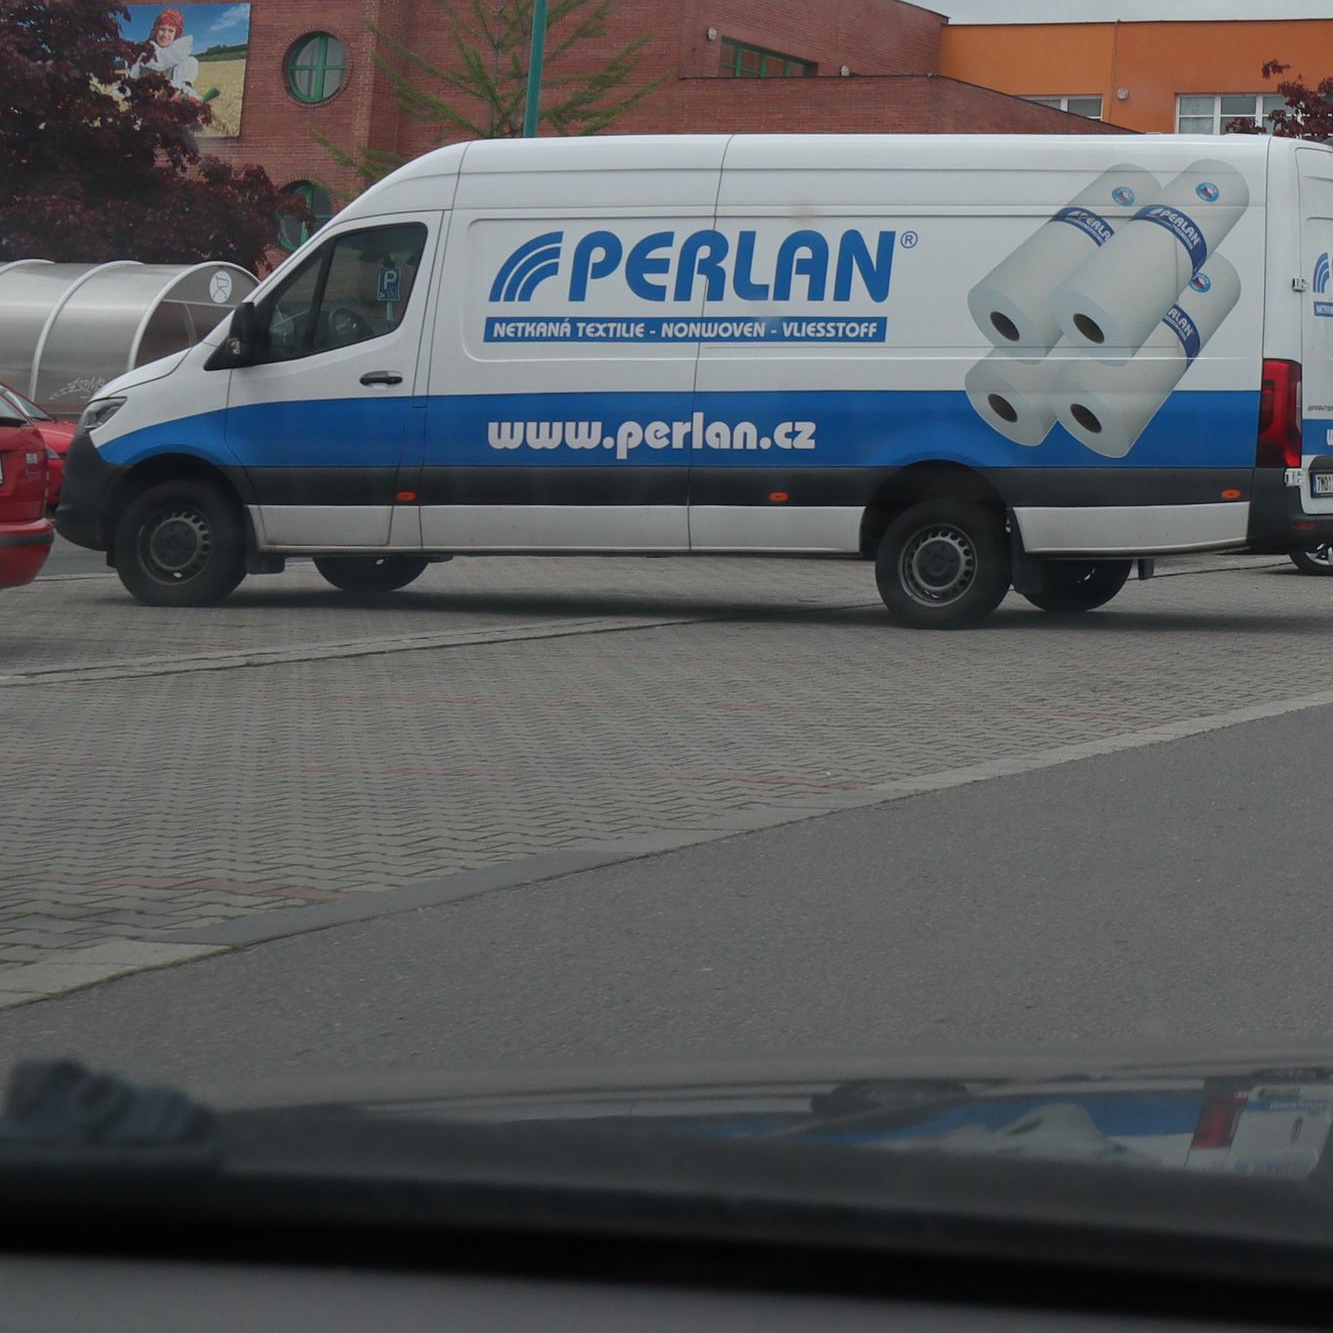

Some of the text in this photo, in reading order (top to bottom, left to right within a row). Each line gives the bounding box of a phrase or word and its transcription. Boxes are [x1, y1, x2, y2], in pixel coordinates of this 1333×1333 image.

[1160, 208, 1199, 246] PERLAN
[492, 318, 572, 338] NETKANÁ
[576, 321, 645, 338] TEXTILIE
[661, 321, 766, 338] NONWOVEN
[782, 321, 878, 338] VLIESSTOFF
[487, 411, 817, 460] www.perlan.cz
